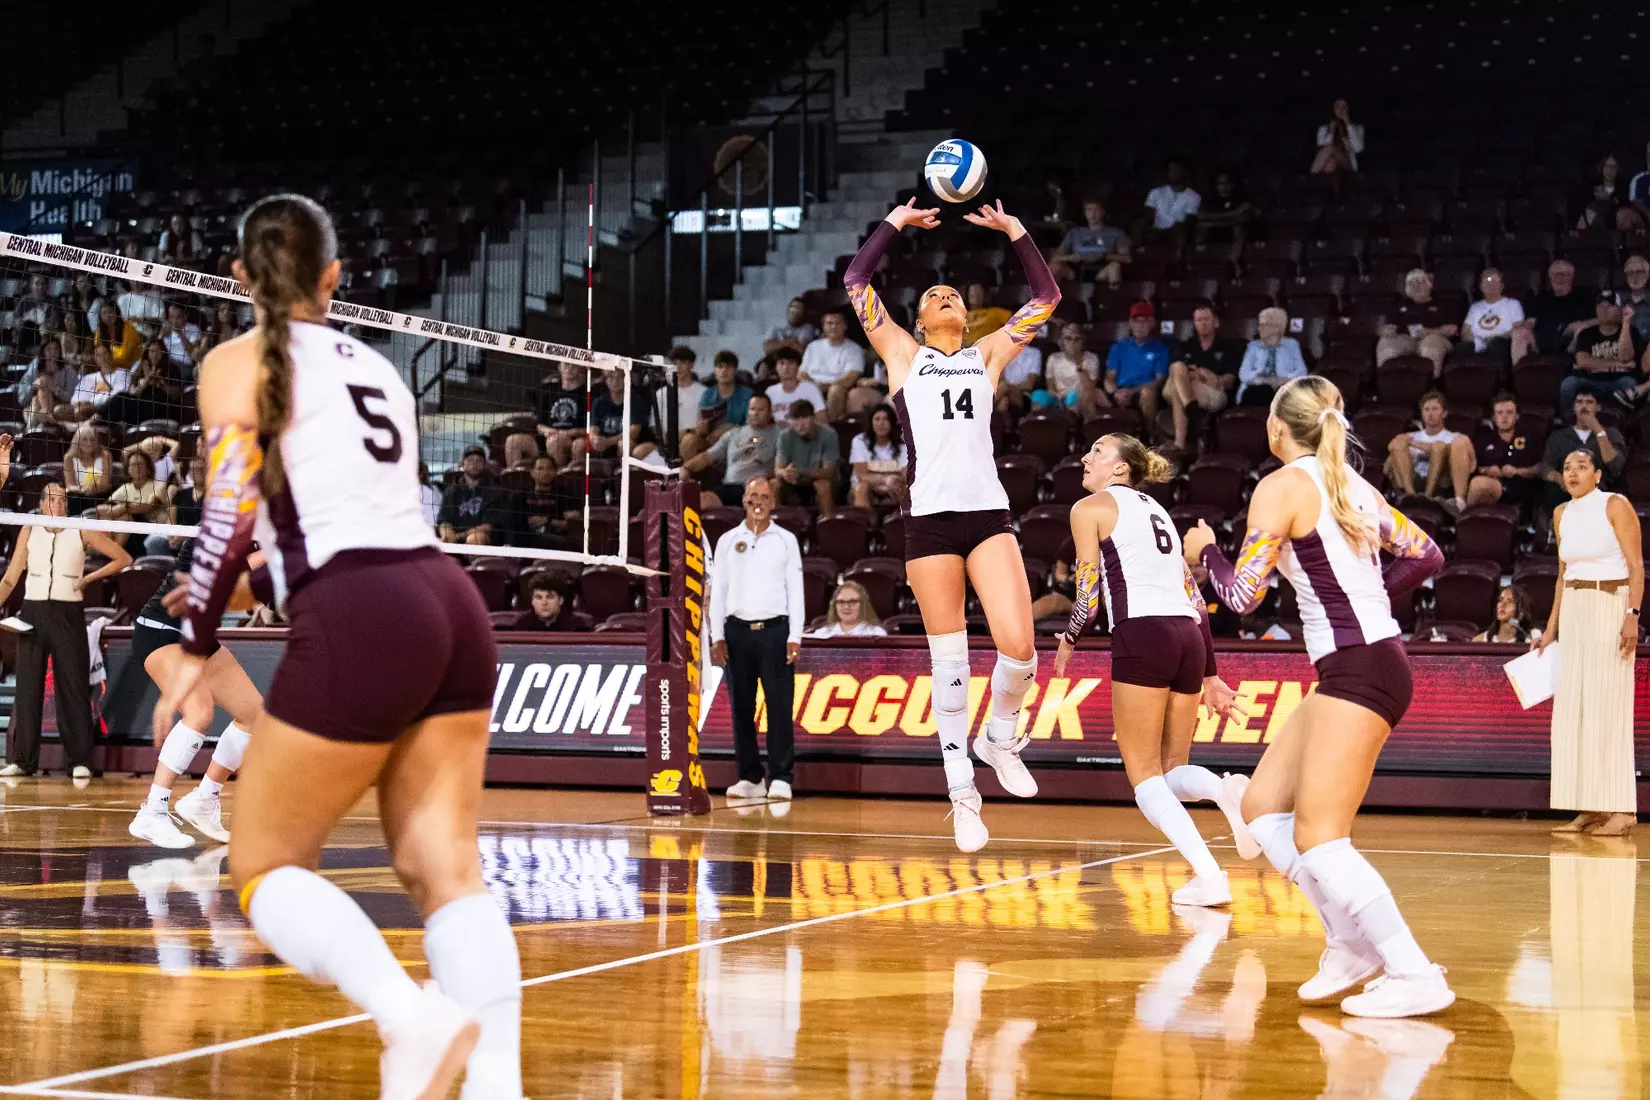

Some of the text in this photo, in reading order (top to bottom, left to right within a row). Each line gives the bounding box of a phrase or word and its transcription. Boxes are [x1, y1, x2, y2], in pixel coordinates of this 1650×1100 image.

[7, 235, 129, 274] CENTRAL MICHIGAN VOLLEYBALL
[166, 269, 197, 287] CENTRAL
[197, 275, 233, 294] MICHIGAN
[330, 302, 395, 325] MICHIGAN VOLLEYBALL
[420, 319, 501, 346] CENTRAL MICHIGAN VOLLEYBALL
[524, 340, 546, 353] CENTRAL
[918, 363, 984, 378] Chippewas
[941, 388, 974, 420] 14
[346, 384, 403, 464] 5
[1150, 513, 1173, 554] 6
[683, 506, 707, 790] CHIPPEWAS
[489, 663, 647, 735] LCOME
[659, 679, 671, 760] sports imports
